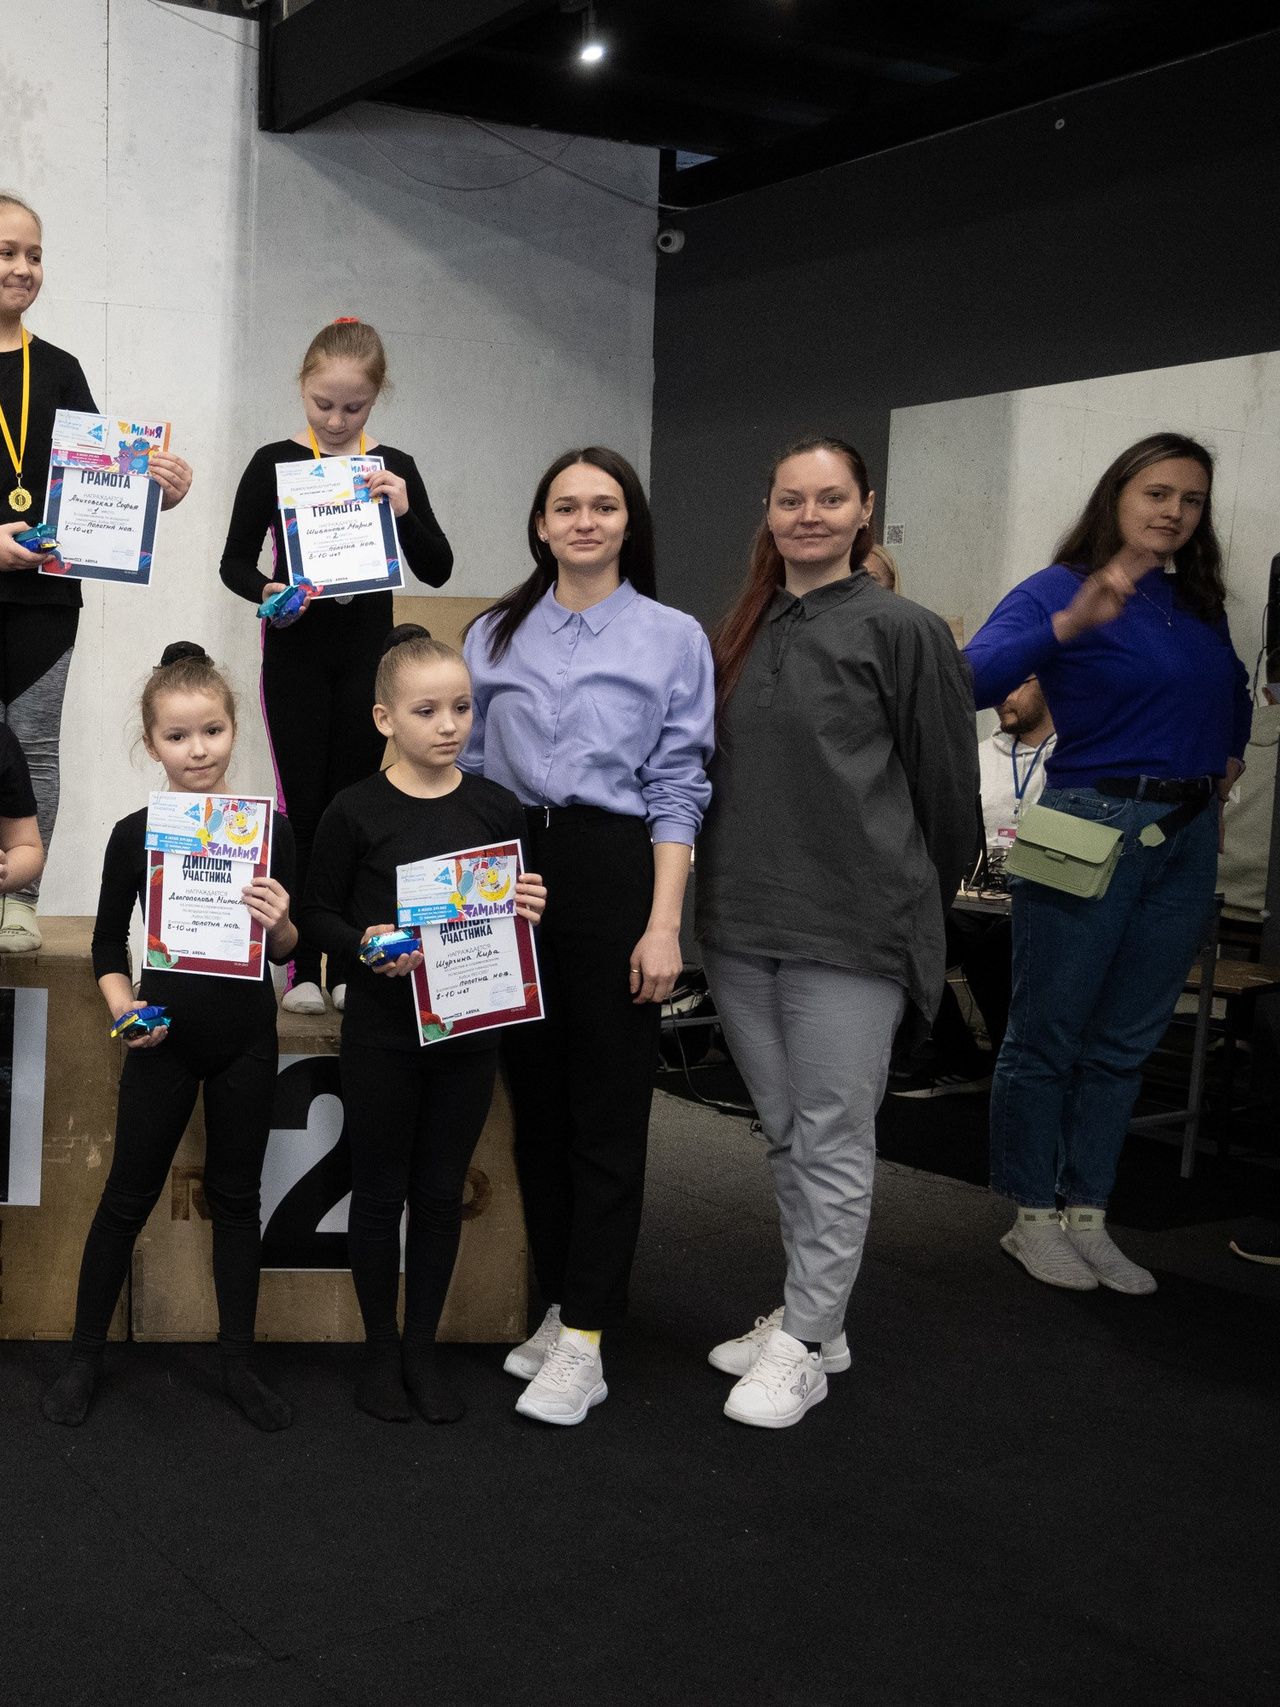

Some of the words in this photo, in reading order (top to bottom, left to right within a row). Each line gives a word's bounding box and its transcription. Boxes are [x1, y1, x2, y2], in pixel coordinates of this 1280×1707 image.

[81, 471, 131, 489] ГРАМОТА
[311, 504, 361, 517] ГРАМОТА
[182, 855, 232, 871] ДИПЛОМ
[182, 870, 232, 884] УЧАСТНИКА
[441, 925, 493, 946] УЧАСТНИКА
[447, 943, 491, 958] НАГРАЖДАЕТСЯ
[476, 949, 500, 958] Кира
